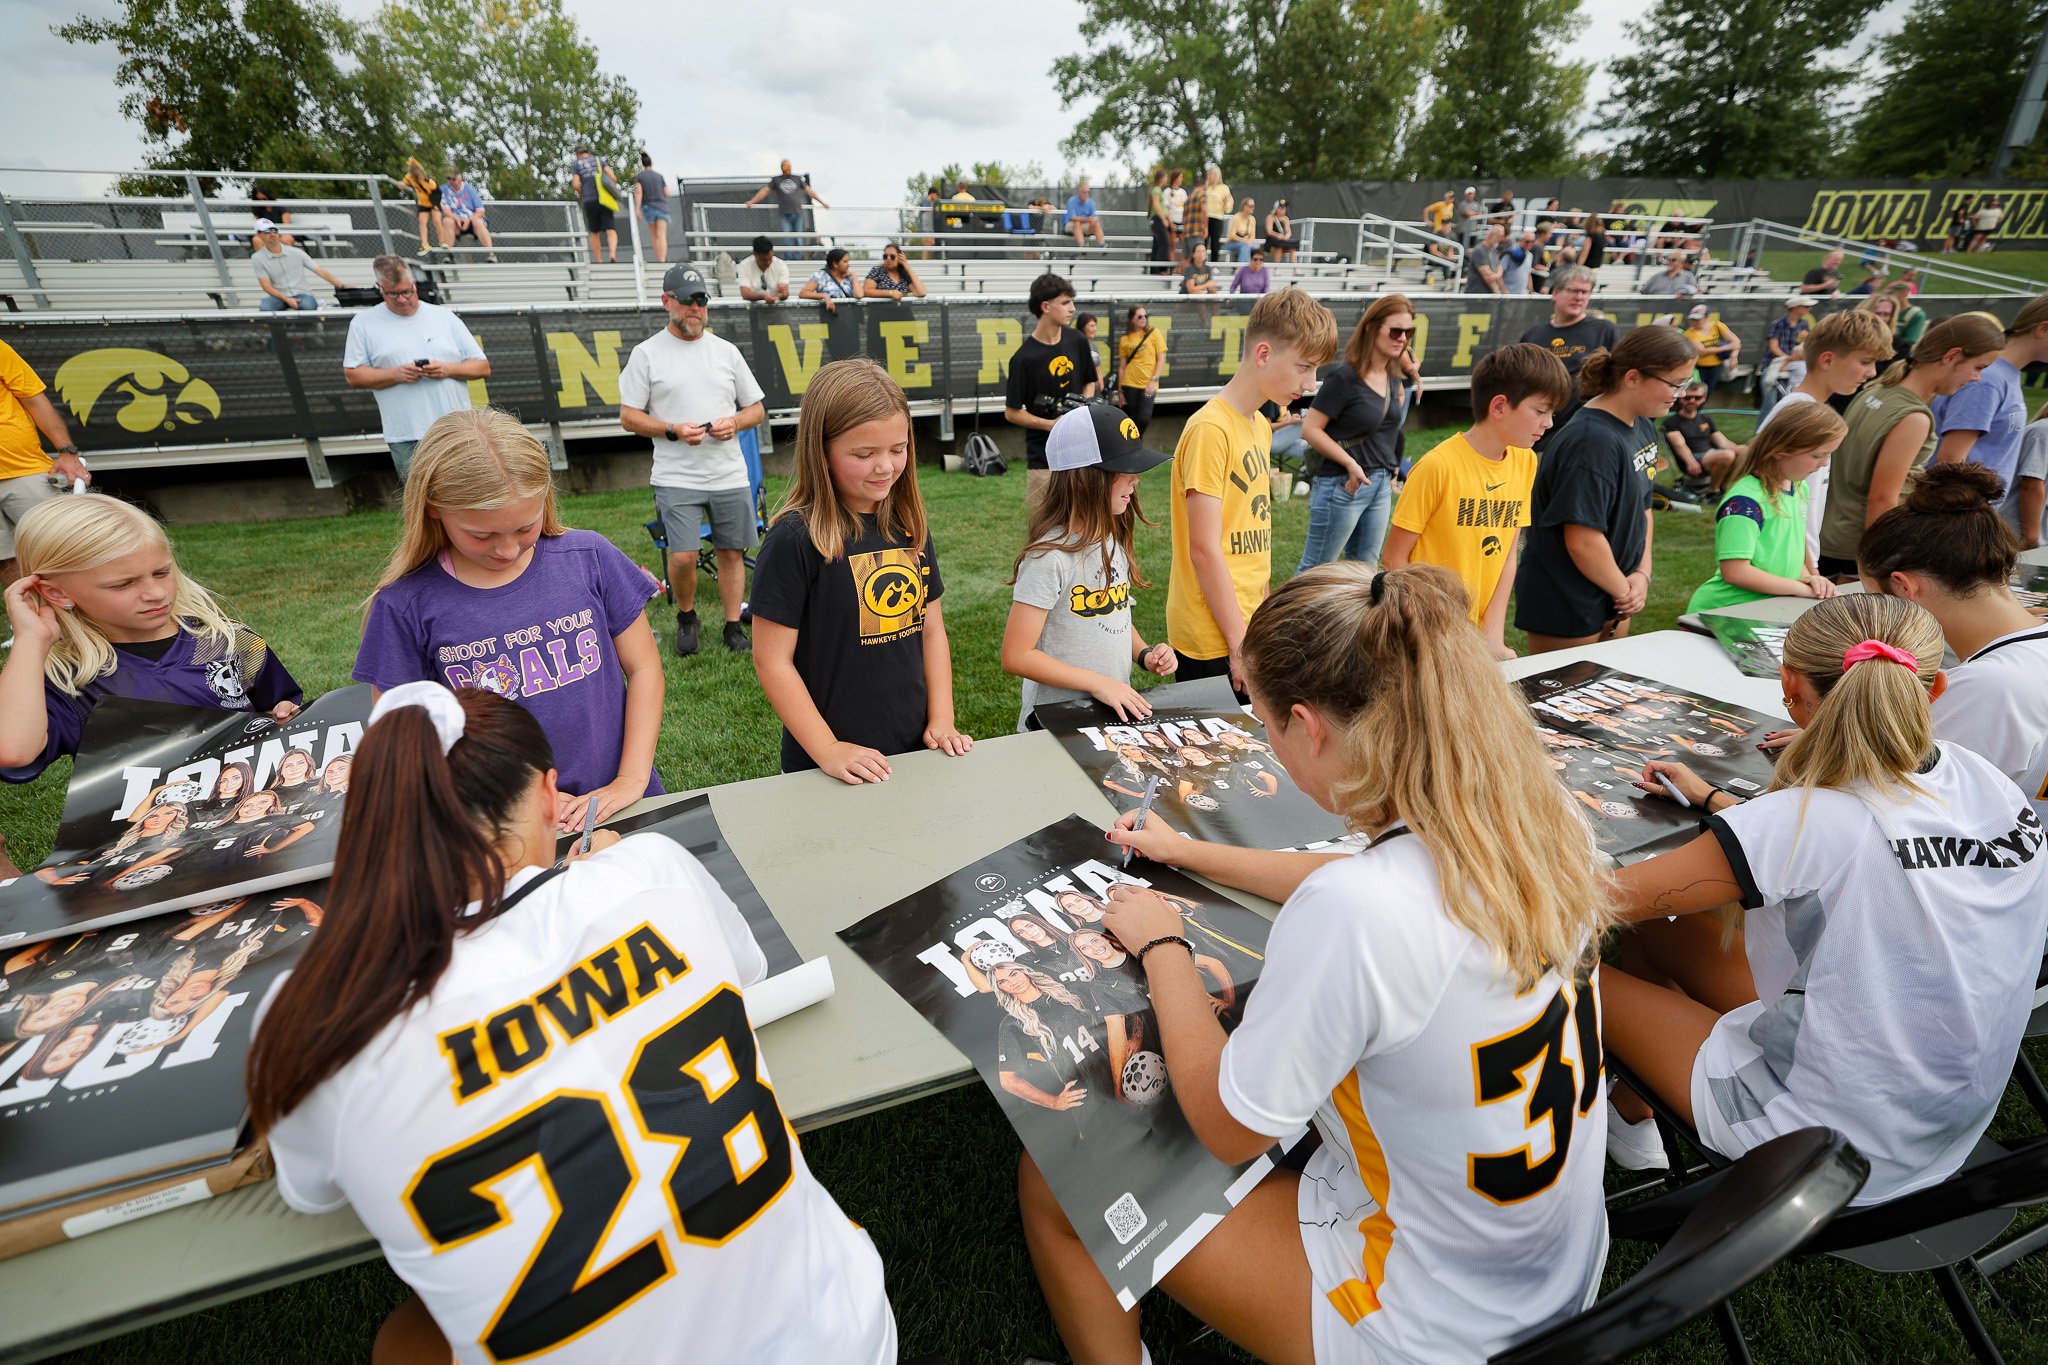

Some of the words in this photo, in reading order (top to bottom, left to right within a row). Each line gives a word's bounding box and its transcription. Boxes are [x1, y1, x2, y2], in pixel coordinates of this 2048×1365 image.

[1800, 189, 1931, 241] IOWA
[439, 637, 497, 663] SHOOT
[504, 625, 543, 650] FOR
[546, 608, 594, 636] YOUR
[860, 635, 897, 646] HAWKEYE
[1213, 780, 1230, 790] 5
[212, 837, 238, 850] 5
[978, 886, 1022, 912] HAWKEYE
[1027, 865, 1061, 885] SOCCER
[436, 920, 692, 1106] IOWA
[1062, 1024, 1100, 1065] 14
[400, 981, 795, 1365] 28
